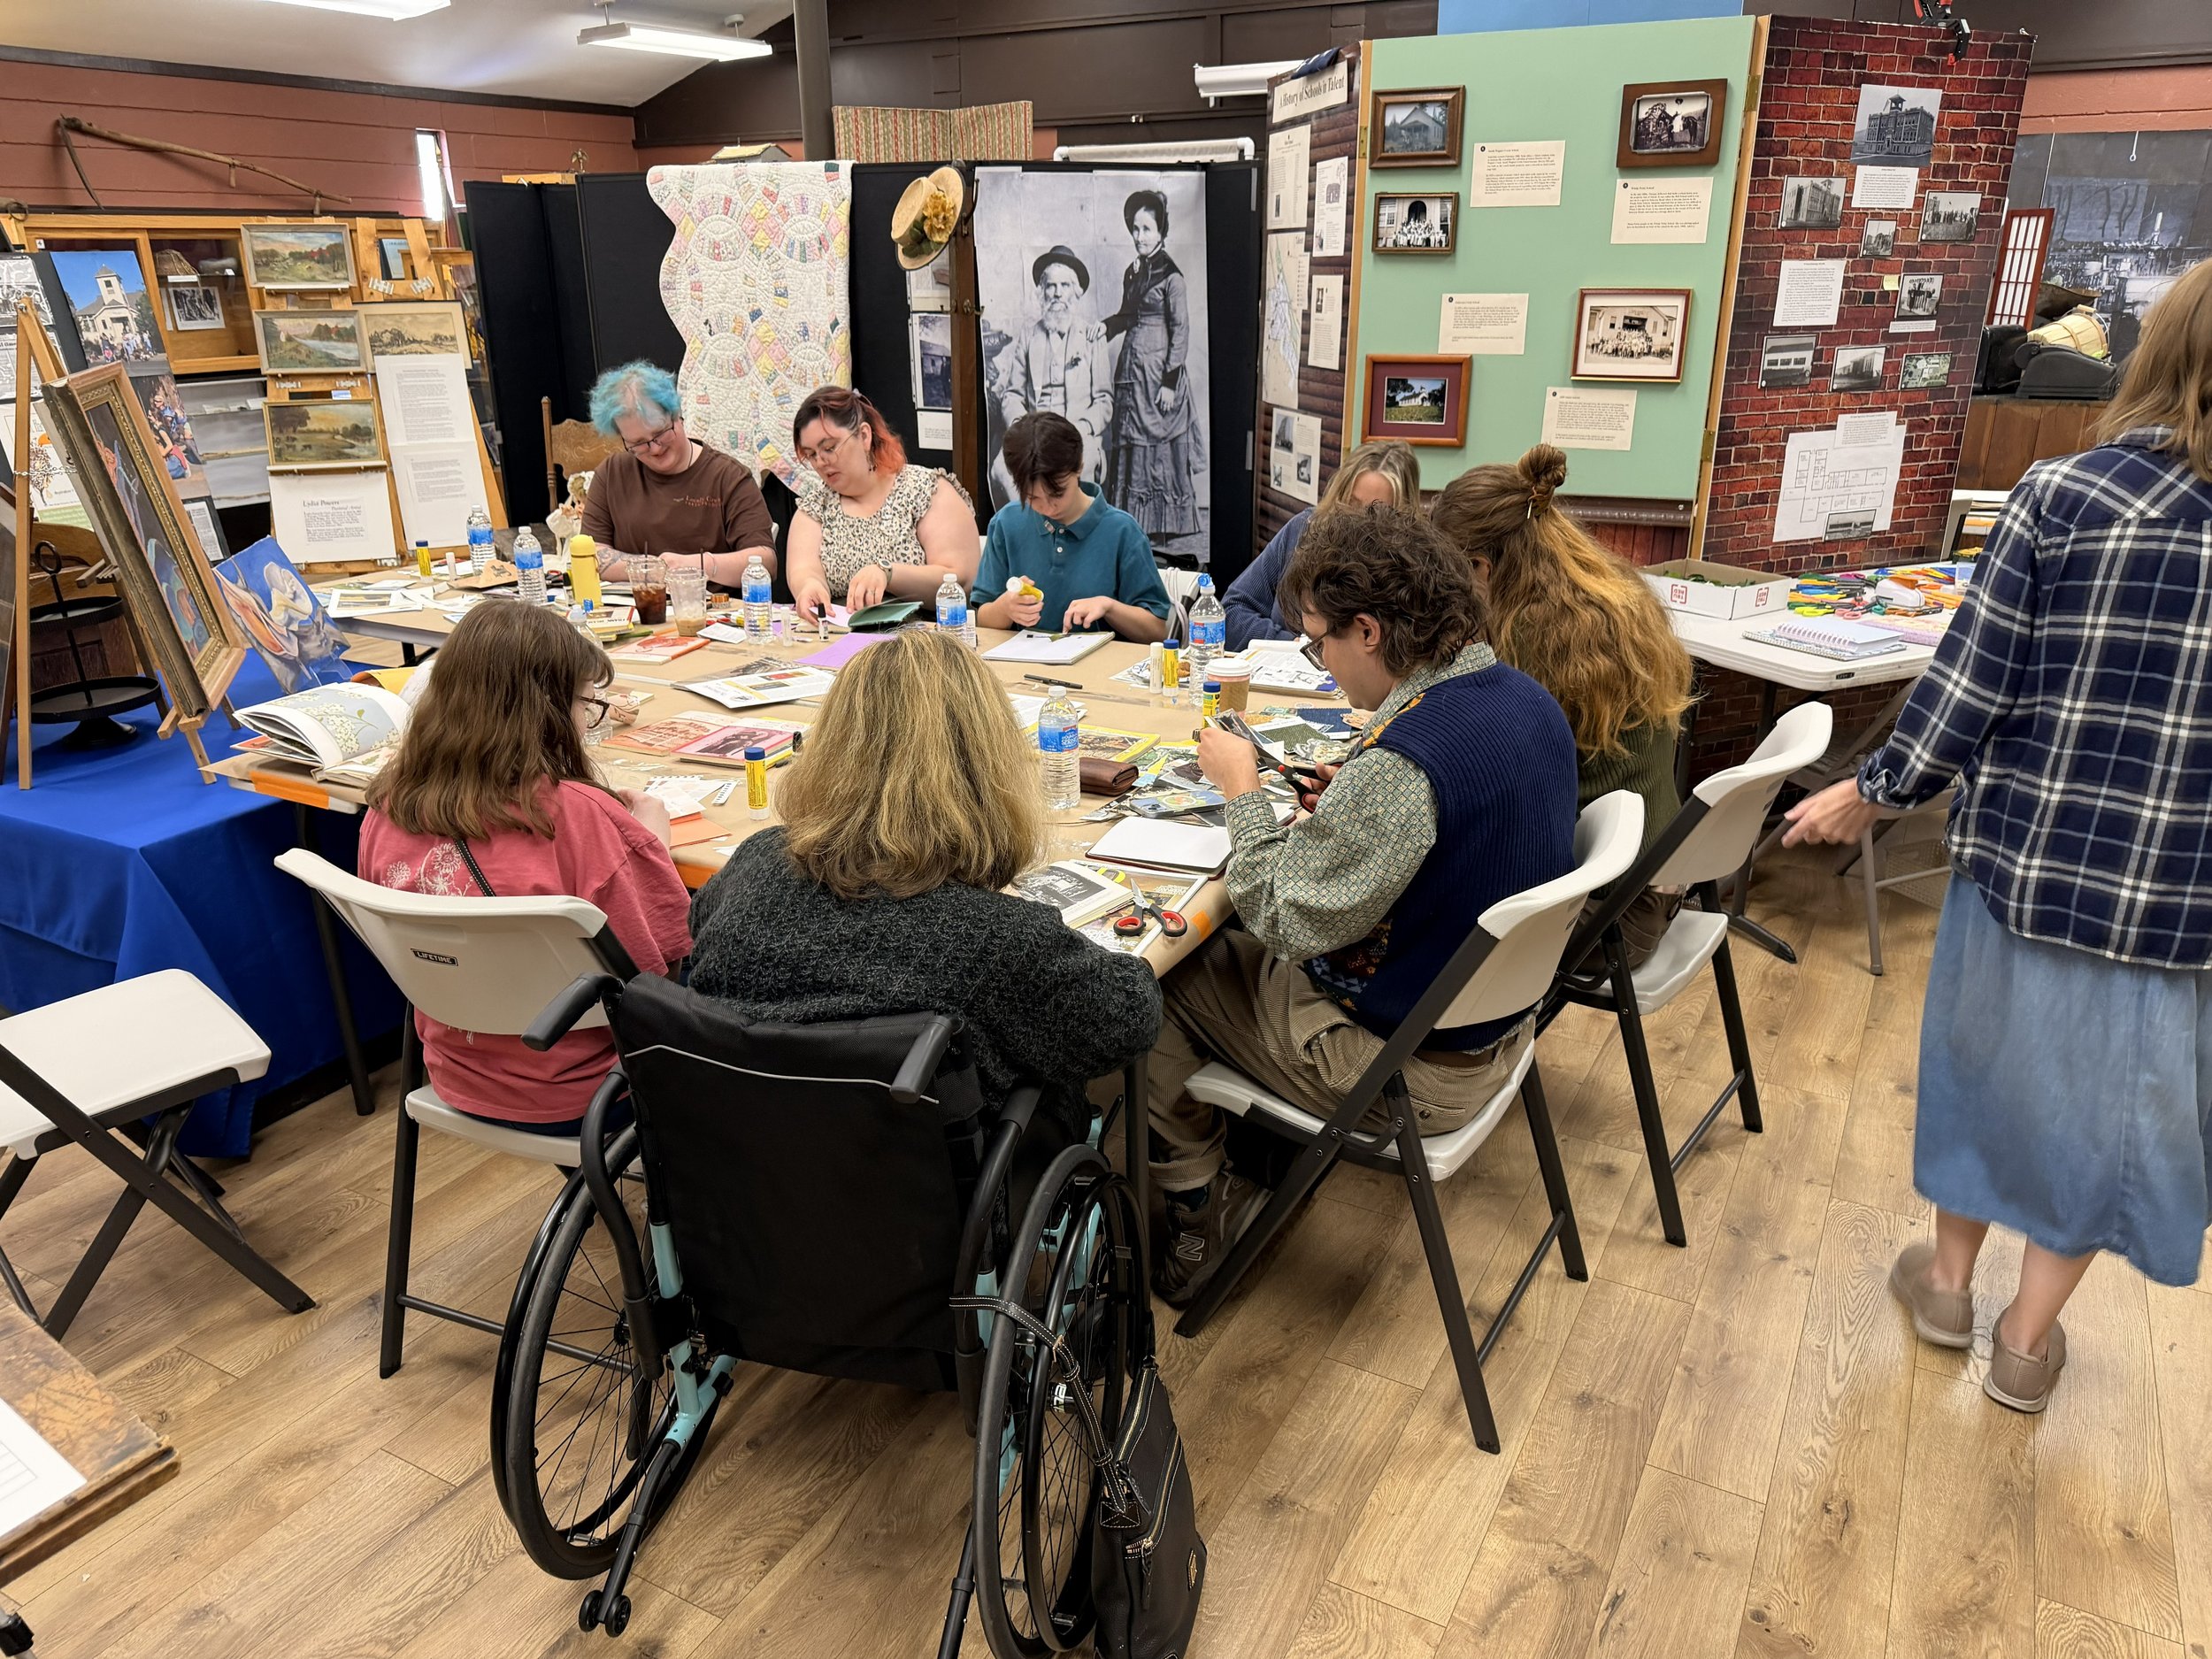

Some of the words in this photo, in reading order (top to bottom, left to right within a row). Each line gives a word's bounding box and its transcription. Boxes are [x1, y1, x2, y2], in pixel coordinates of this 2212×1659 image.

[1282, 92, 1298, 106] History
[1304, 82, 1322, 99] Schools
[1328, 75, 1345, 92] Talent
[417, 951, 452, 964] LIFETIME
[1175, 1232, 1205, 1262] N
